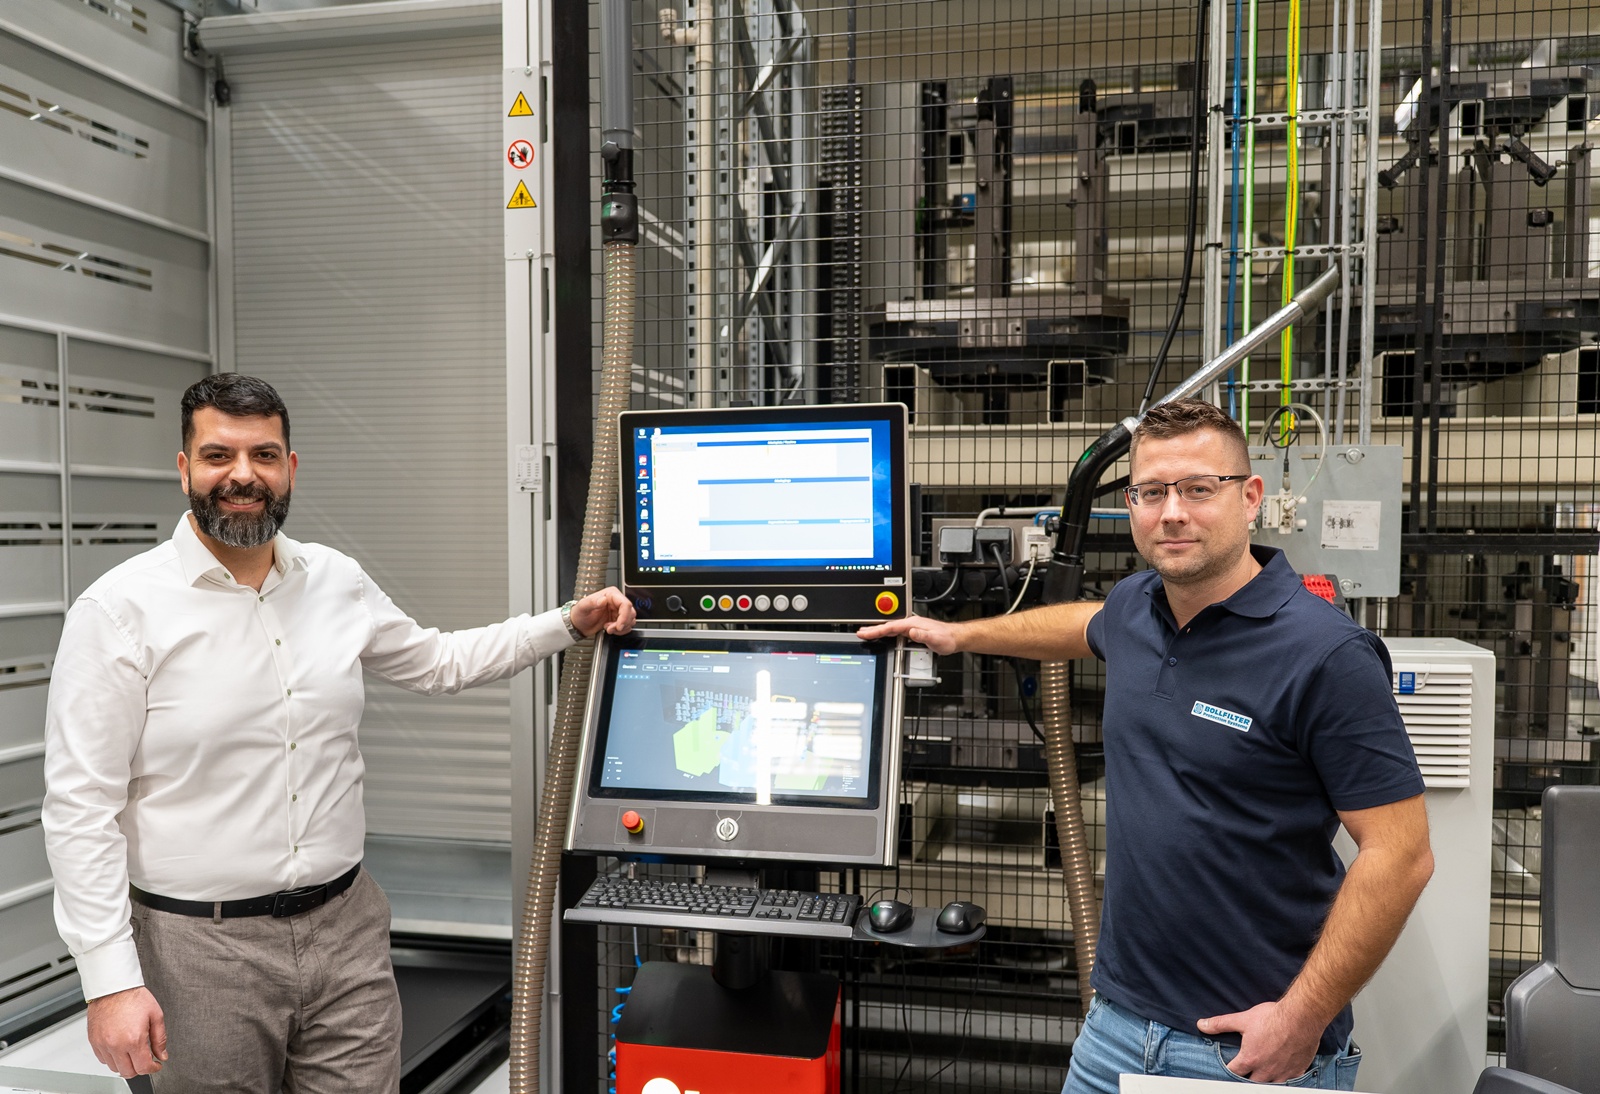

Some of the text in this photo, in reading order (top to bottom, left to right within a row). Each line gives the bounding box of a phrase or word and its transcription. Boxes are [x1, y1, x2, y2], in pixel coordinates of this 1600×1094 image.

[1203, 712, 1248, 730] Protection Systems
[1204, 706, 1250, 725] BOLLFILTER
